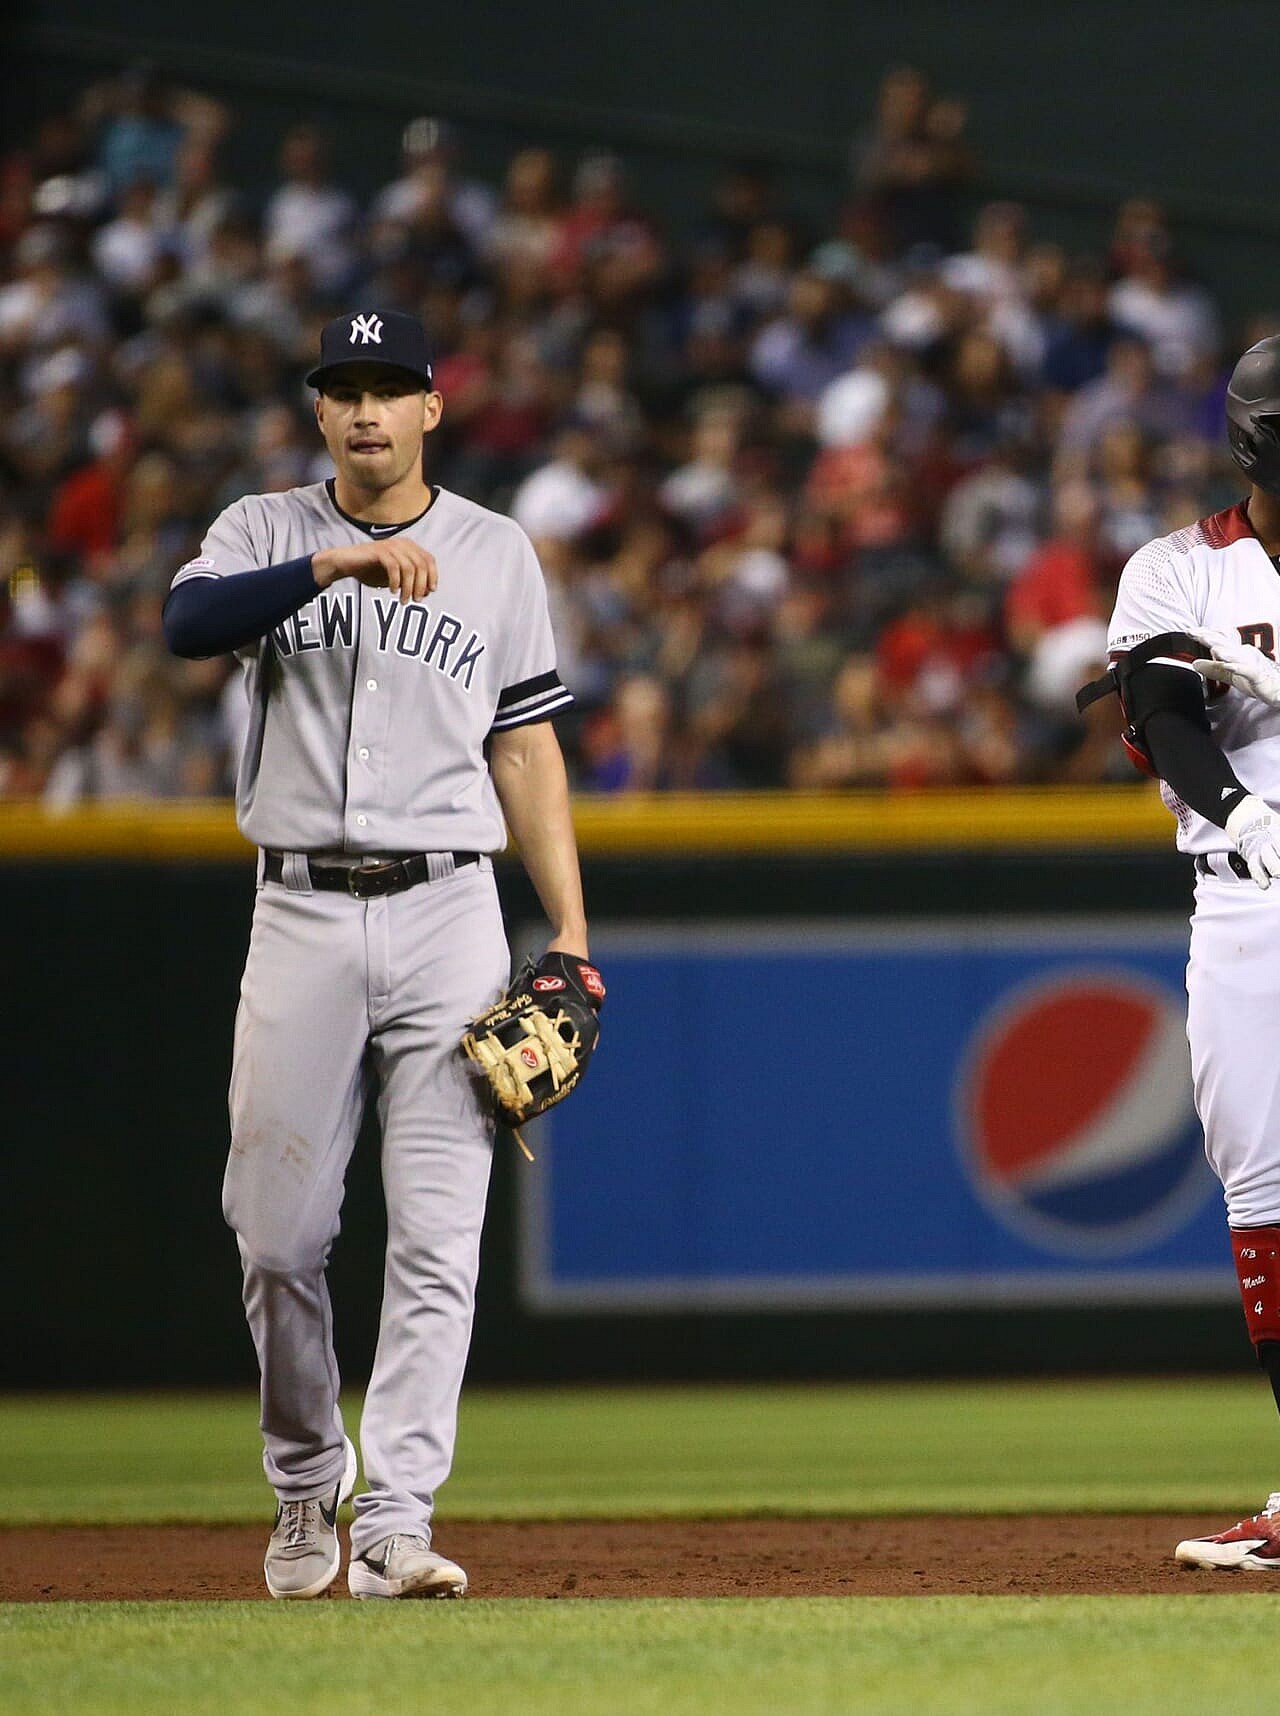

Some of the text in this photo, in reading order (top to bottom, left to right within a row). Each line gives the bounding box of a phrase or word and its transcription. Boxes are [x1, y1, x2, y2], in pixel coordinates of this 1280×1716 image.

[349, 312, 384, 345] NY
[271, 592, 488, 694] NEW YORK
[1242, 1275, 1266, 1289] Marte
[1254, 1300, 1263, 1315] 4
